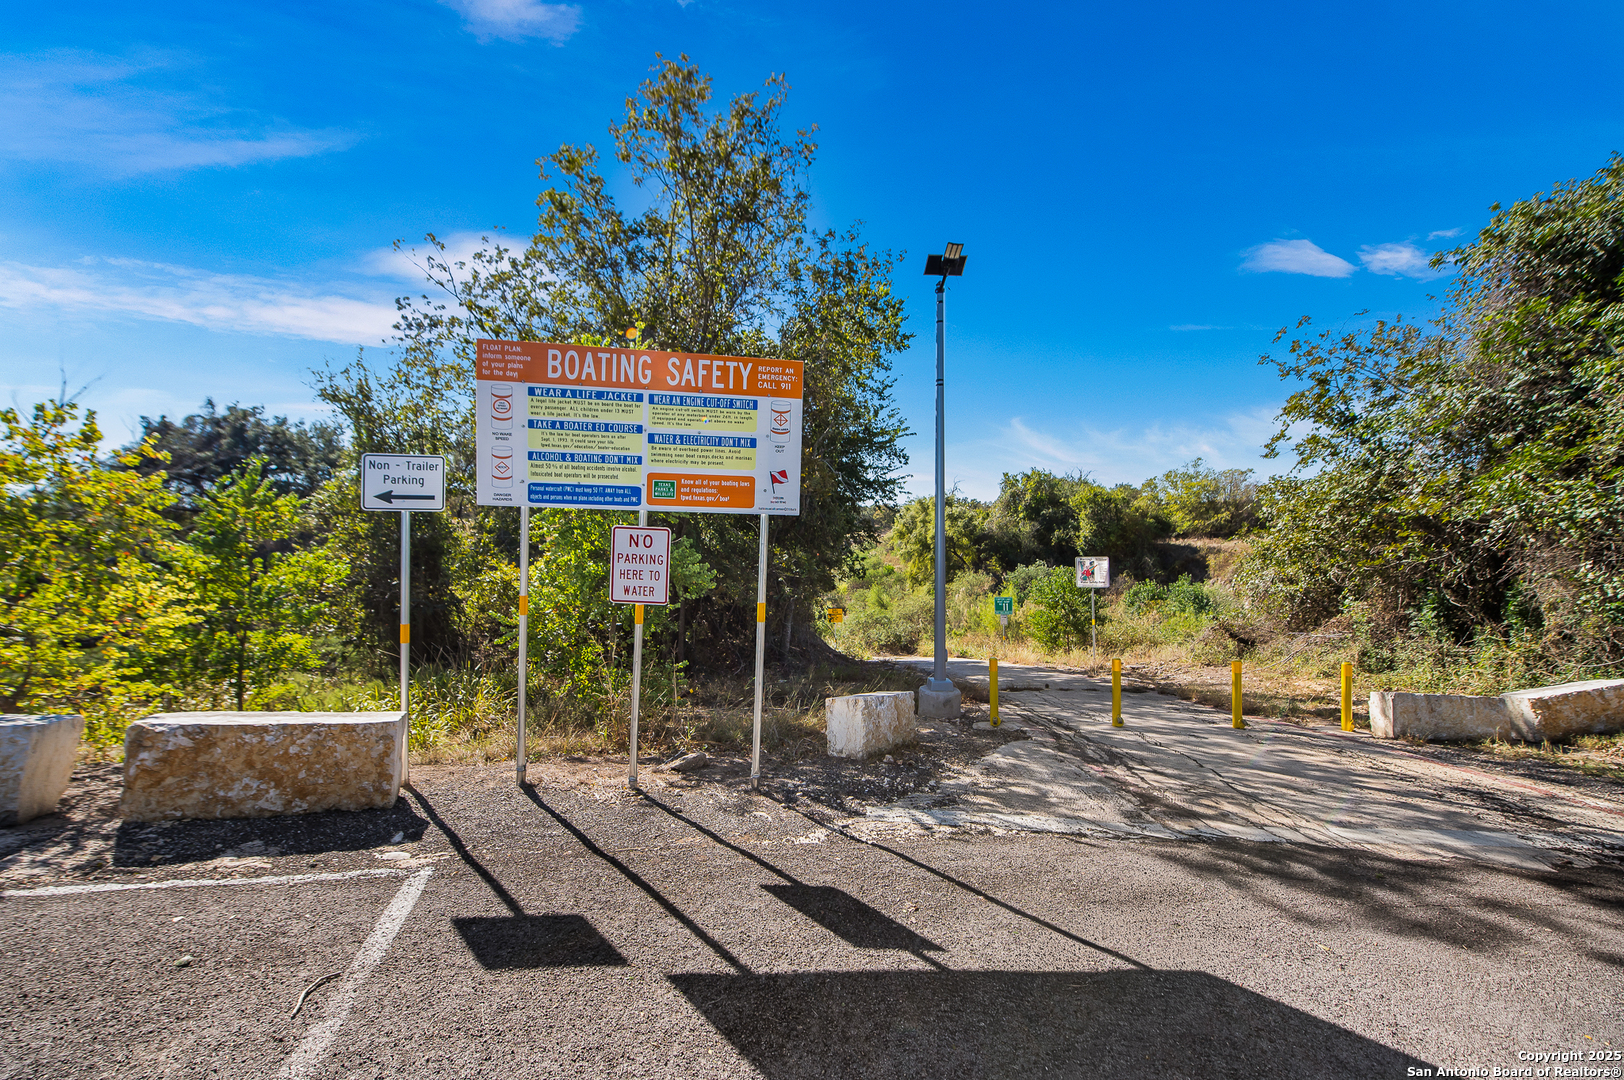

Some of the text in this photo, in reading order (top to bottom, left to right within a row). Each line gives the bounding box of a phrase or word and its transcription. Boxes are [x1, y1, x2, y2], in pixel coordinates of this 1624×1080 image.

[547, 349, 753, 390] BOATING SAFETY
[758, 374, 798, 382] EMERGENCY:
[758, 381, 777, 389] CALL
[534, 388, 561, 397] WEAR
[577, 390, 596, 399] LIFE
[602, 392, 637, 401] JACKET
[654, 395, 754, 409] WEAR AN ENGINE CUT-OFF SWITCH
[564, 422, 592, 430] BOATER
[609, 424, 637, 432] COURSE
[654, 435, 750, 447] WATER & ELECTRICITY DON'T MIX
[532, 453, 562, 461] ALCOHOL
[575, 454, 602, 462] BOATING
[369, 460, 390, 470] Non
[406, 461, 439, 471] Trailer
[383, 474, 424, 487] Parking
[629, 534, 653, 548] NO
[617, 553, 663, 565] PARKING
[620, 569, 660, 581] HERE TO
[624, 585, 654, 596] WATER
